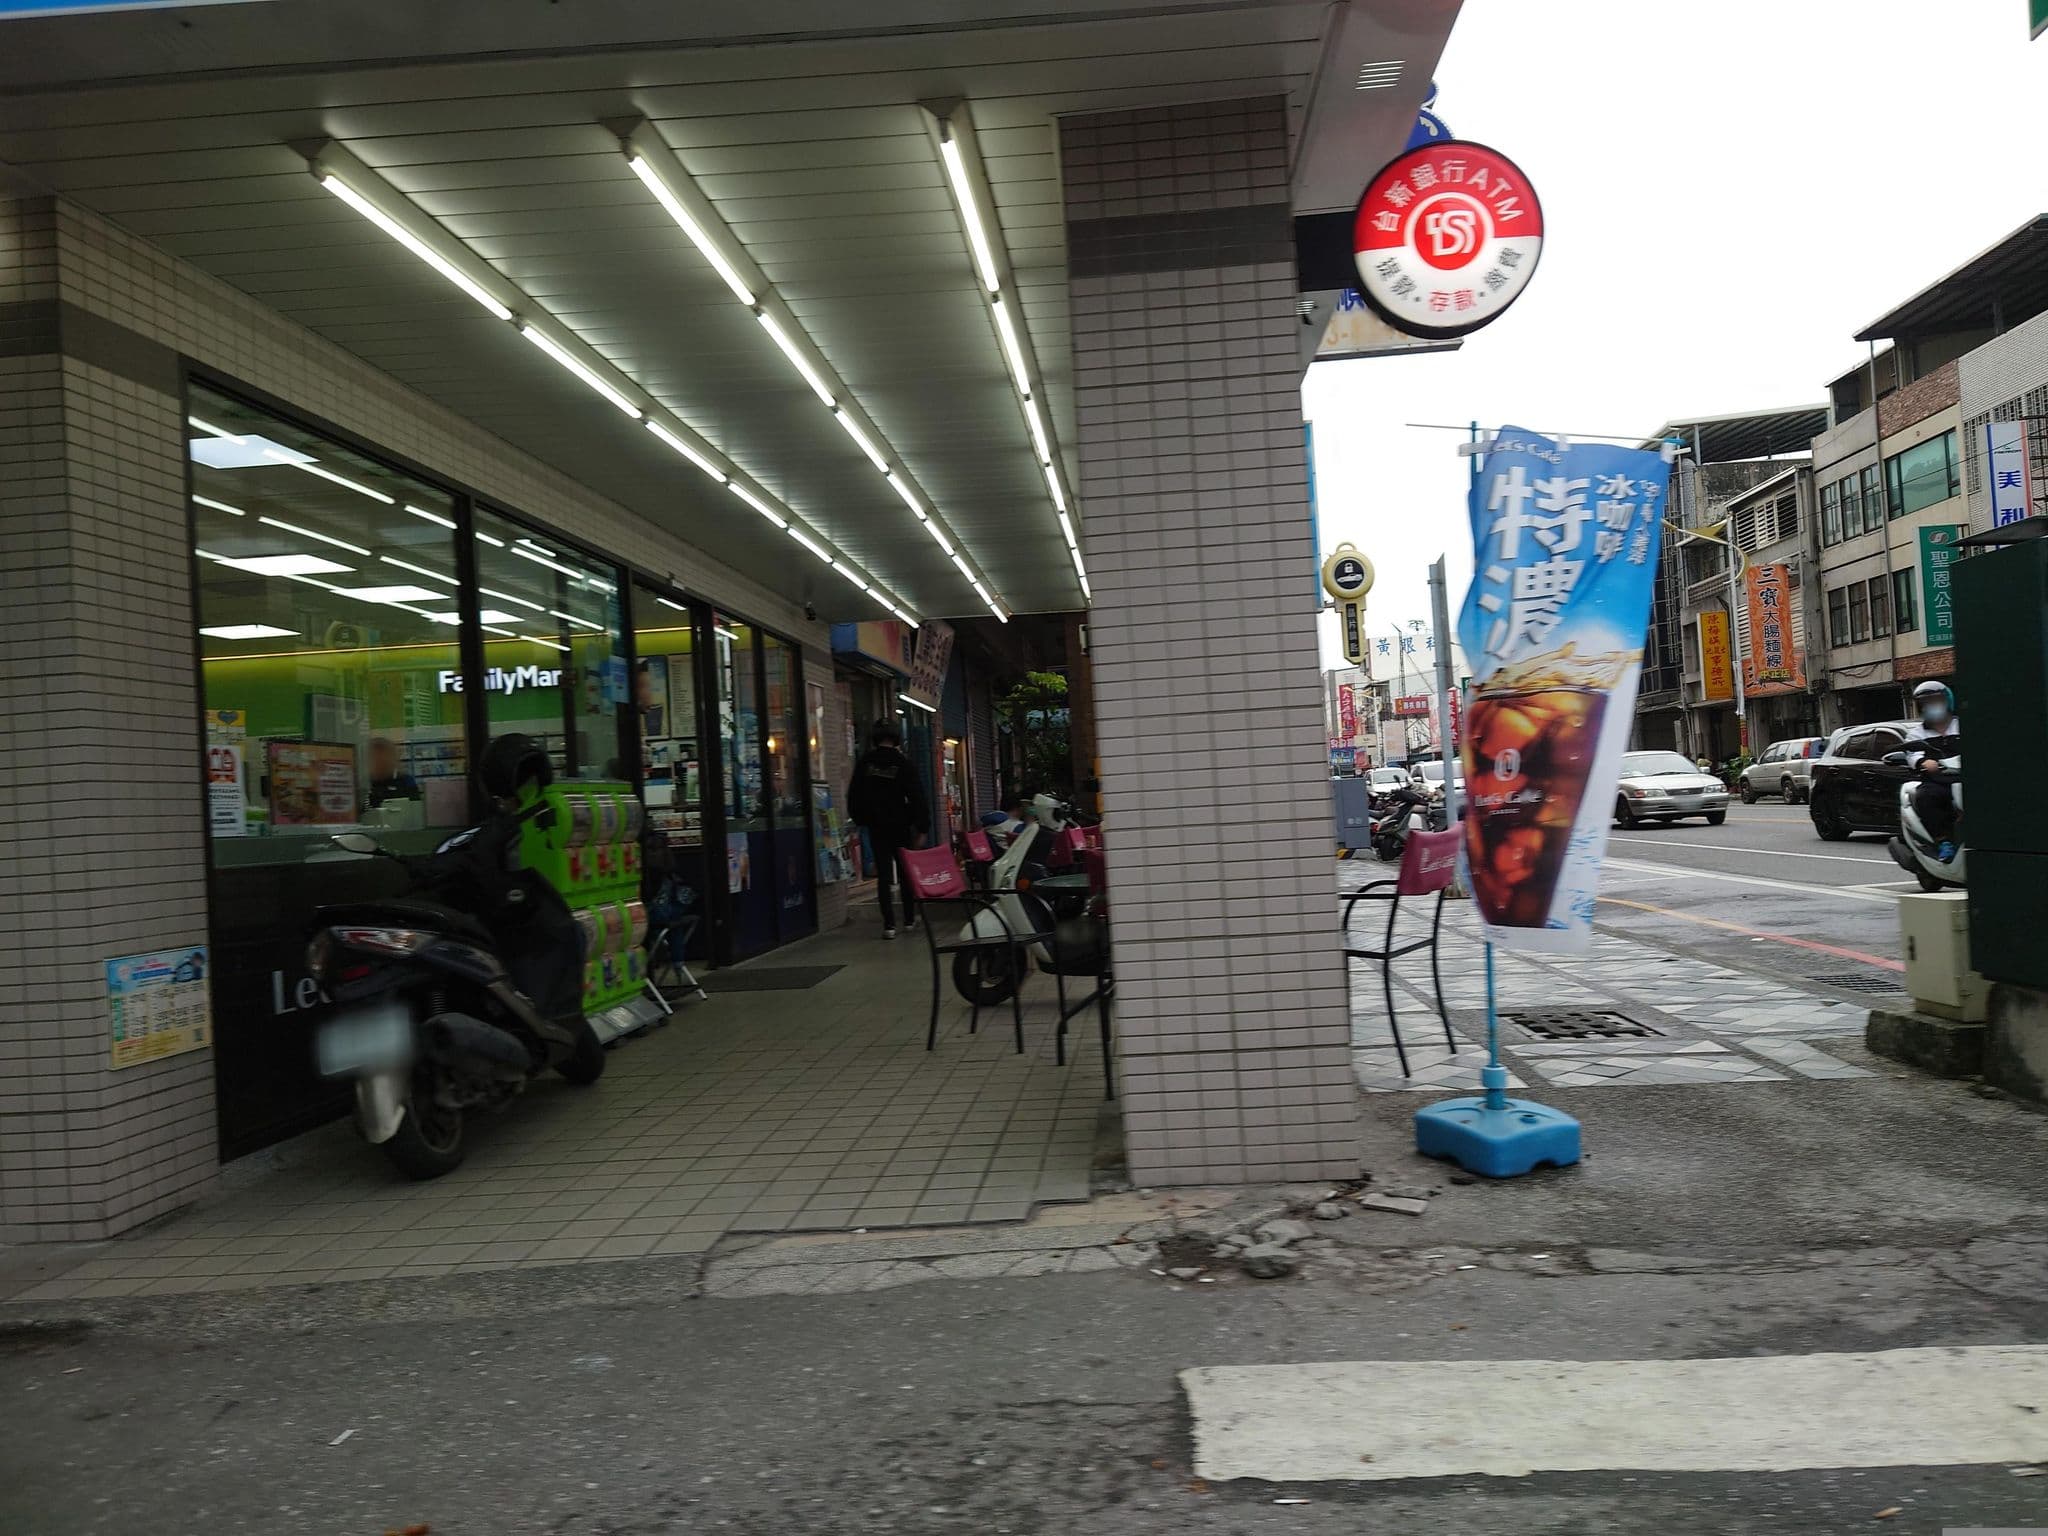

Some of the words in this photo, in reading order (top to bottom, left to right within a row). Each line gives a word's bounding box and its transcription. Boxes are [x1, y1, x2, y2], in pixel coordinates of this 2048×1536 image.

[1478, 466, 1593, 660] 特濃
[1595, 473, 1638, 565] 冰咖啡
[1757, 566, 1782, 669] 三寶大腸麵線
[1930, 550, 1953, 629] 聖恩公司
[438, 664, 563, 695] FailyMar
